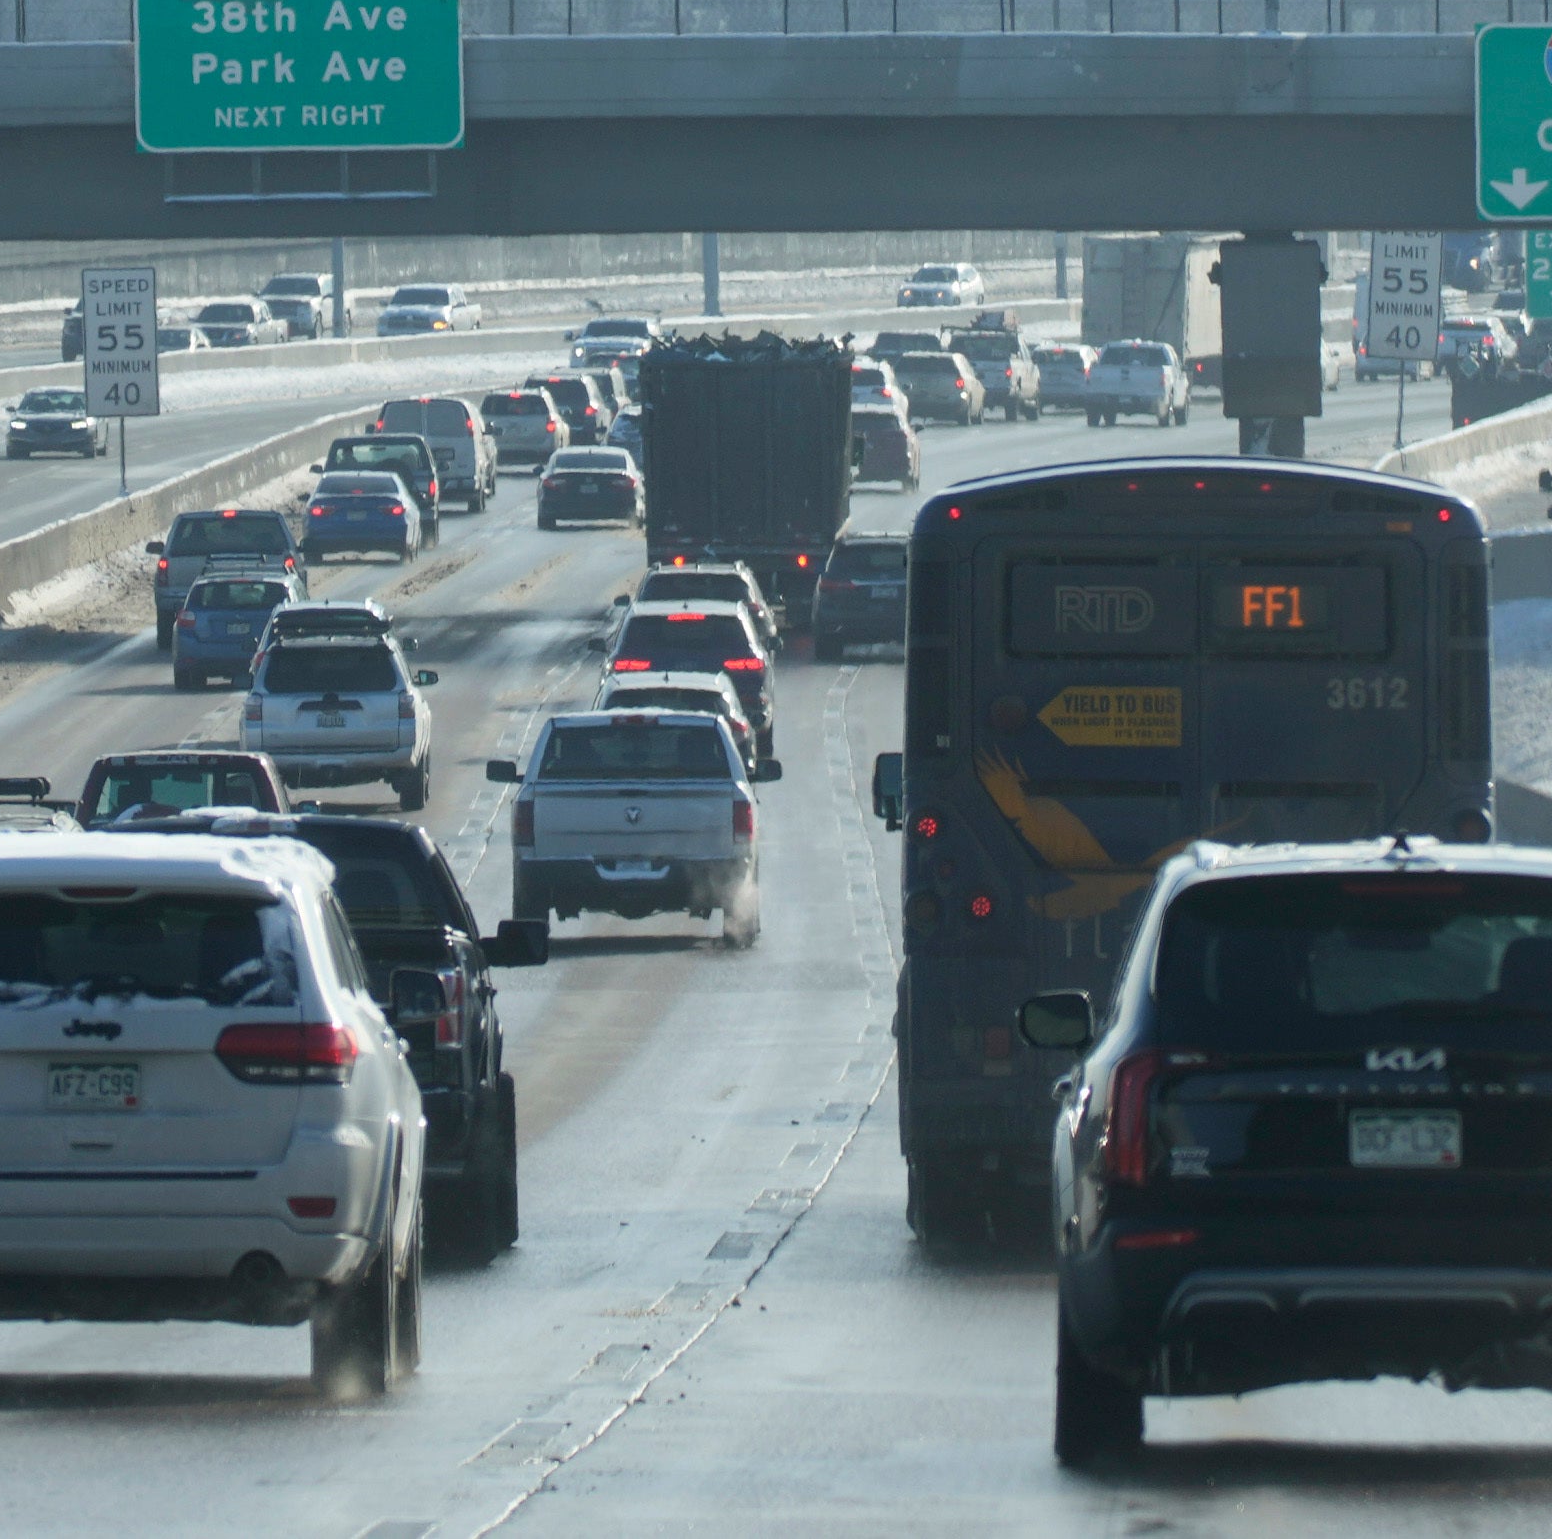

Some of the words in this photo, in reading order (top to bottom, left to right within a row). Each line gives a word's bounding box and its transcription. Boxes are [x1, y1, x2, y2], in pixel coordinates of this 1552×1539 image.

[192, 2, 296, 33] 38th
[324, 0, 407, 30] Ave
[192, 53, 295, 84] Park
[322, 51, 406, 82] Ave
[215, 106, 285, 127] NEXT
[302, 104, 385, 126] RIGHT
[1384, 245, 1429, 260] LIMIT
[88, 277, 149, 294] SPEED
[1382, 267, 1429, 294] 55
[95, 300, 143, 316] LIMIT
[1375, 300, 1433, 317] MINIMUM
[97, 325, 145, 352] 55
[1385, 326, 1421, 349] 40
[91, 359, 151, 374] MINIMUM
[104, 383, 141, 406] 40
[1054, 586, 1154, 634] RTD
[1242, 585, 1305, 628] FF1
[1063, 694, 1111, 713] YIELD
[1115, 694, 1137, 713] TO
[1142, 694, 1176, 714] BUS
[1326, 677, 1410, 711] 3612
[62, 1018, 122, 1041] Jeep
[1365, 1047, 1446, 1072] KIA
